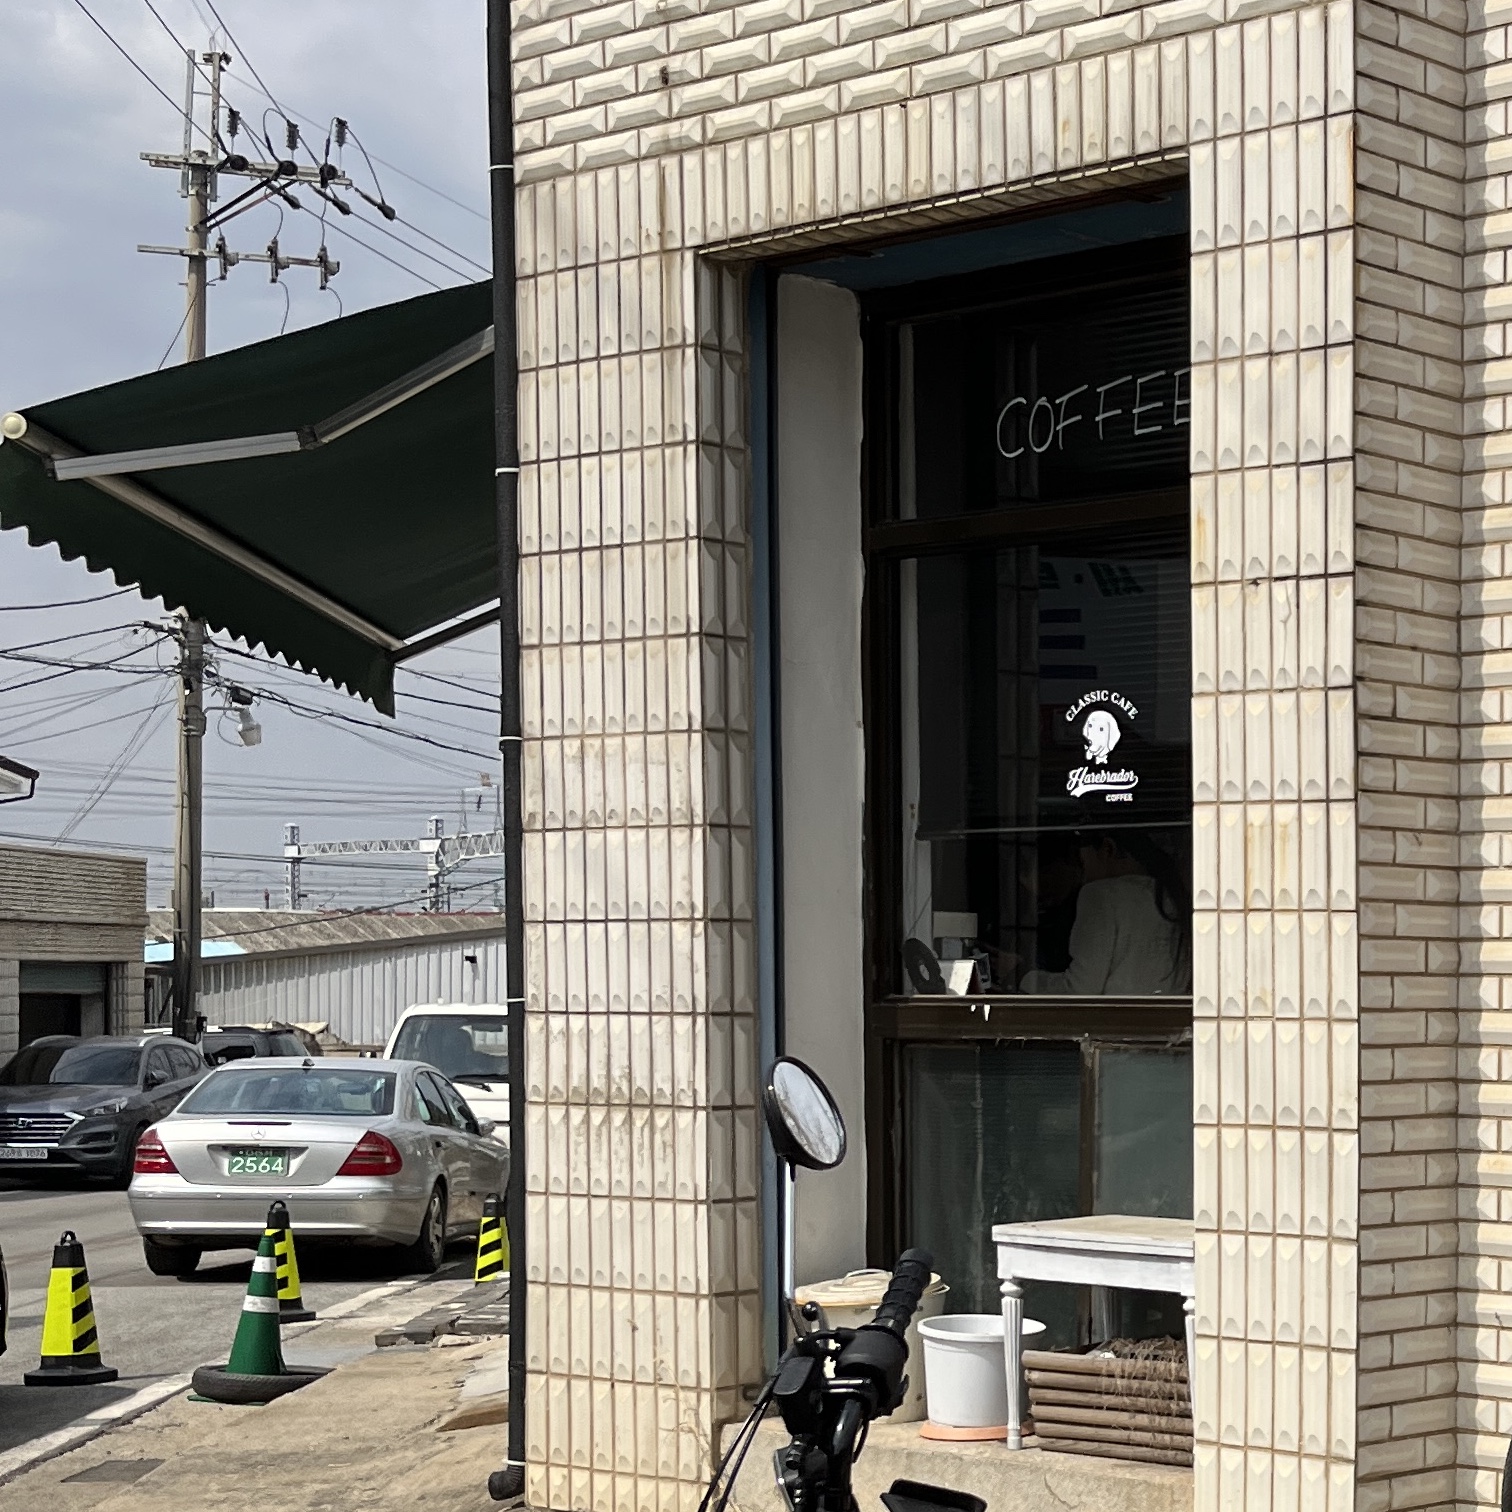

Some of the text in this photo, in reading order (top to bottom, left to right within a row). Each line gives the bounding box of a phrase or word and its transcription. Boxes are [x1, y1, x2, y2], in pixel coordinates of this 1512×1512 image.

[997, 369, 1190, 458] COFFEE
[1065, 690, 1139, 722] CLASSIC CAFE
[1066, 766, 1139, 797] Harebrador
[1105, 793, 1133, 802] COFFEE
[231, 1156, 284, 1173] 2564
